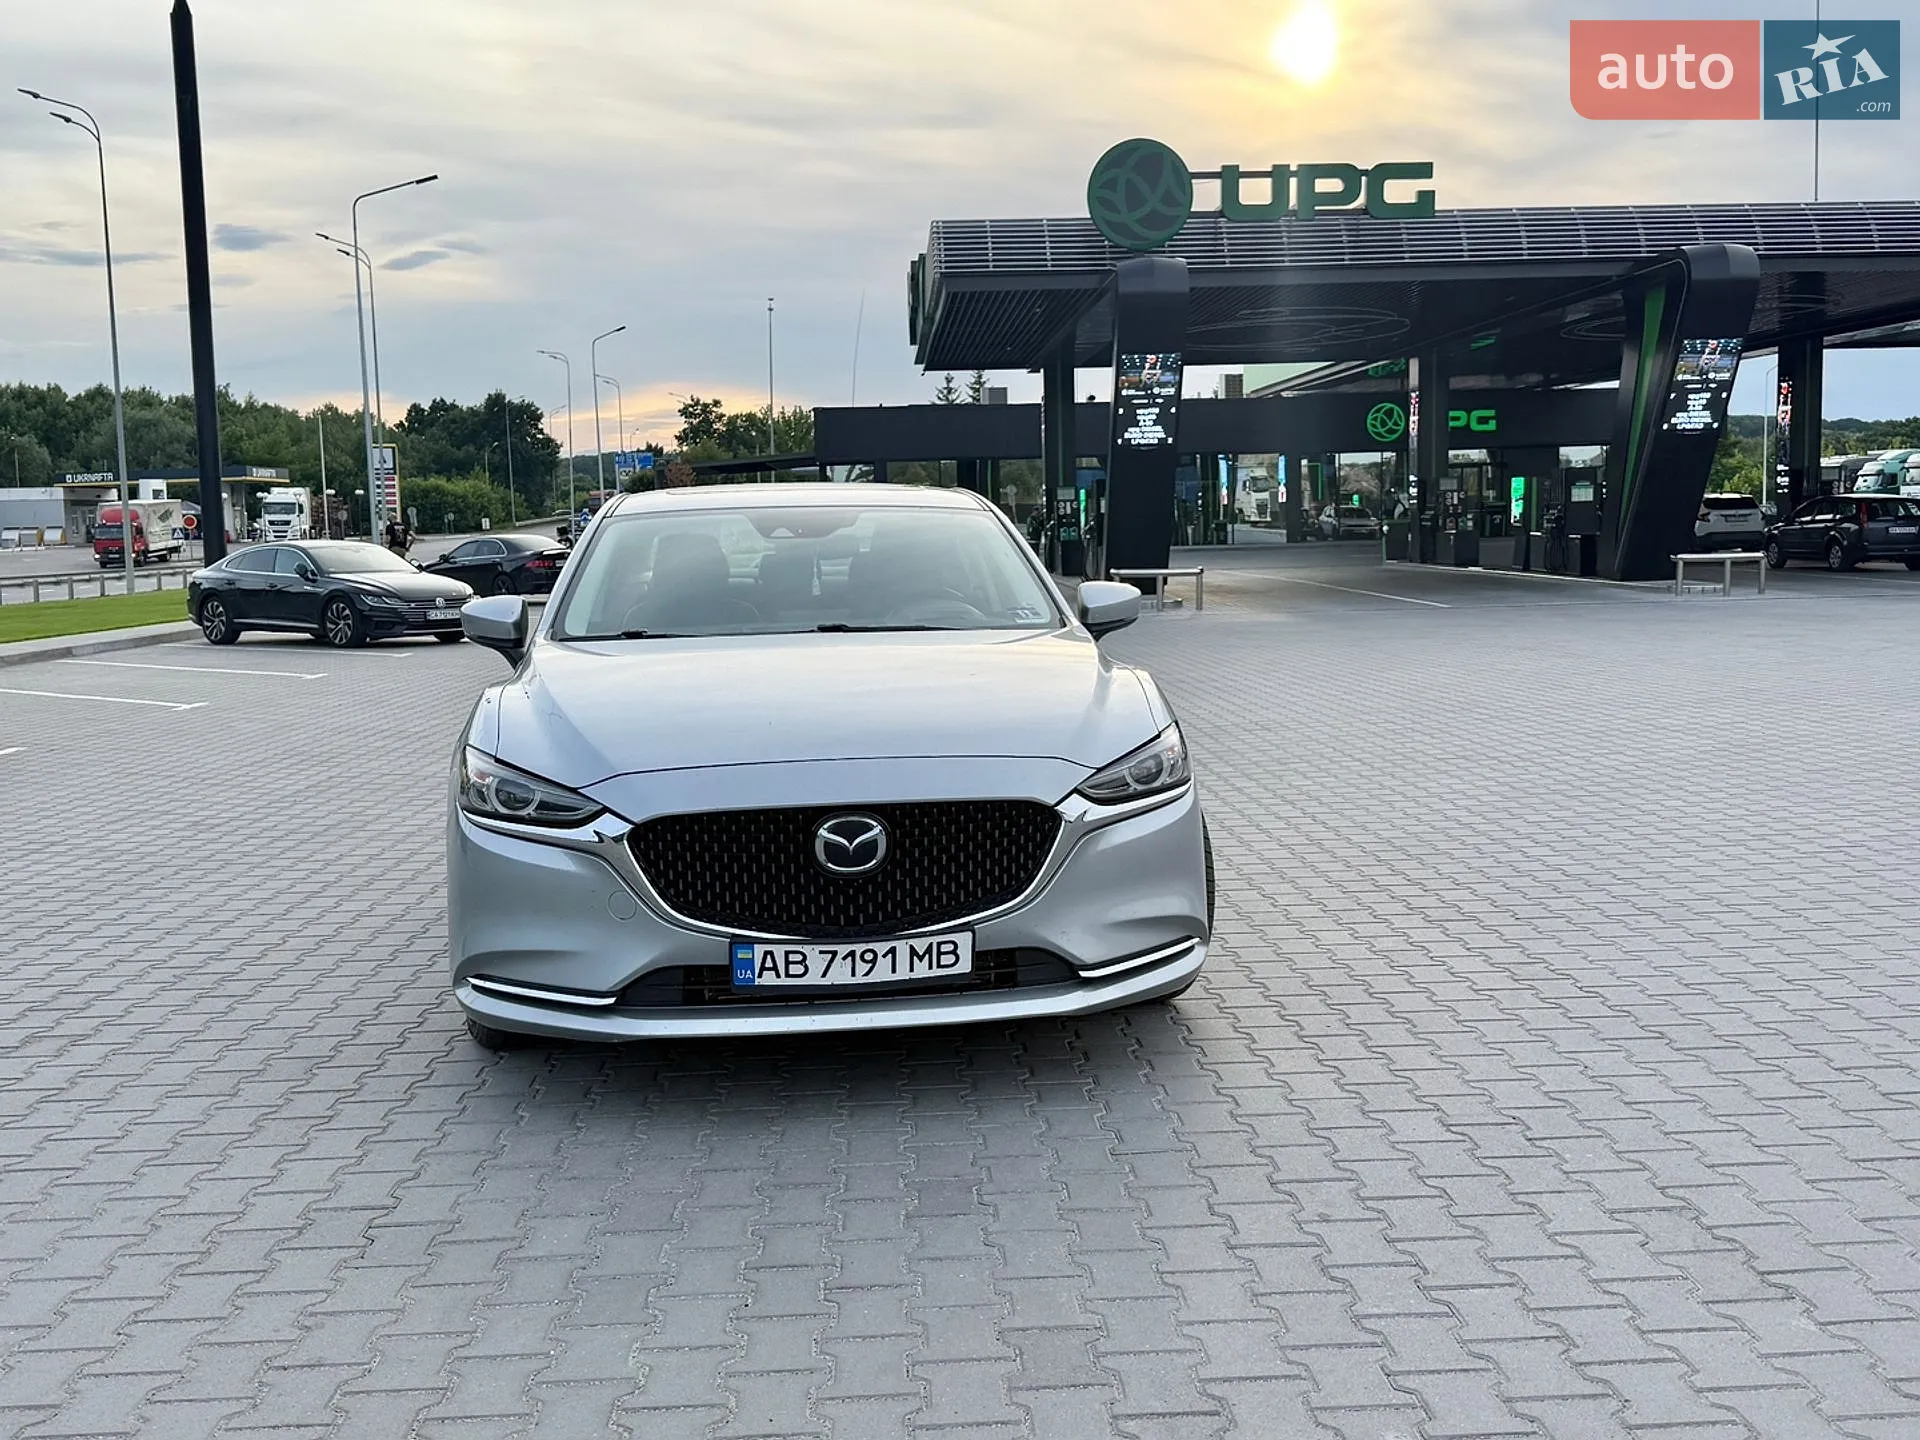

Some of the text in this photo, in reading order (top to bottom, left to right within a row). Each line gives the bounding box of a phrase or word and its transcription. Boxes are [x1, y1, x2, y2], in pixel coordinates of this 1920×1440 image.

[1221, 162, 1436, 221] UPG
[1448, 409, 1497, 431] PG
[737, 969, 754, 980] UA
[756, 939, 961, 979] AB 7191 MB
